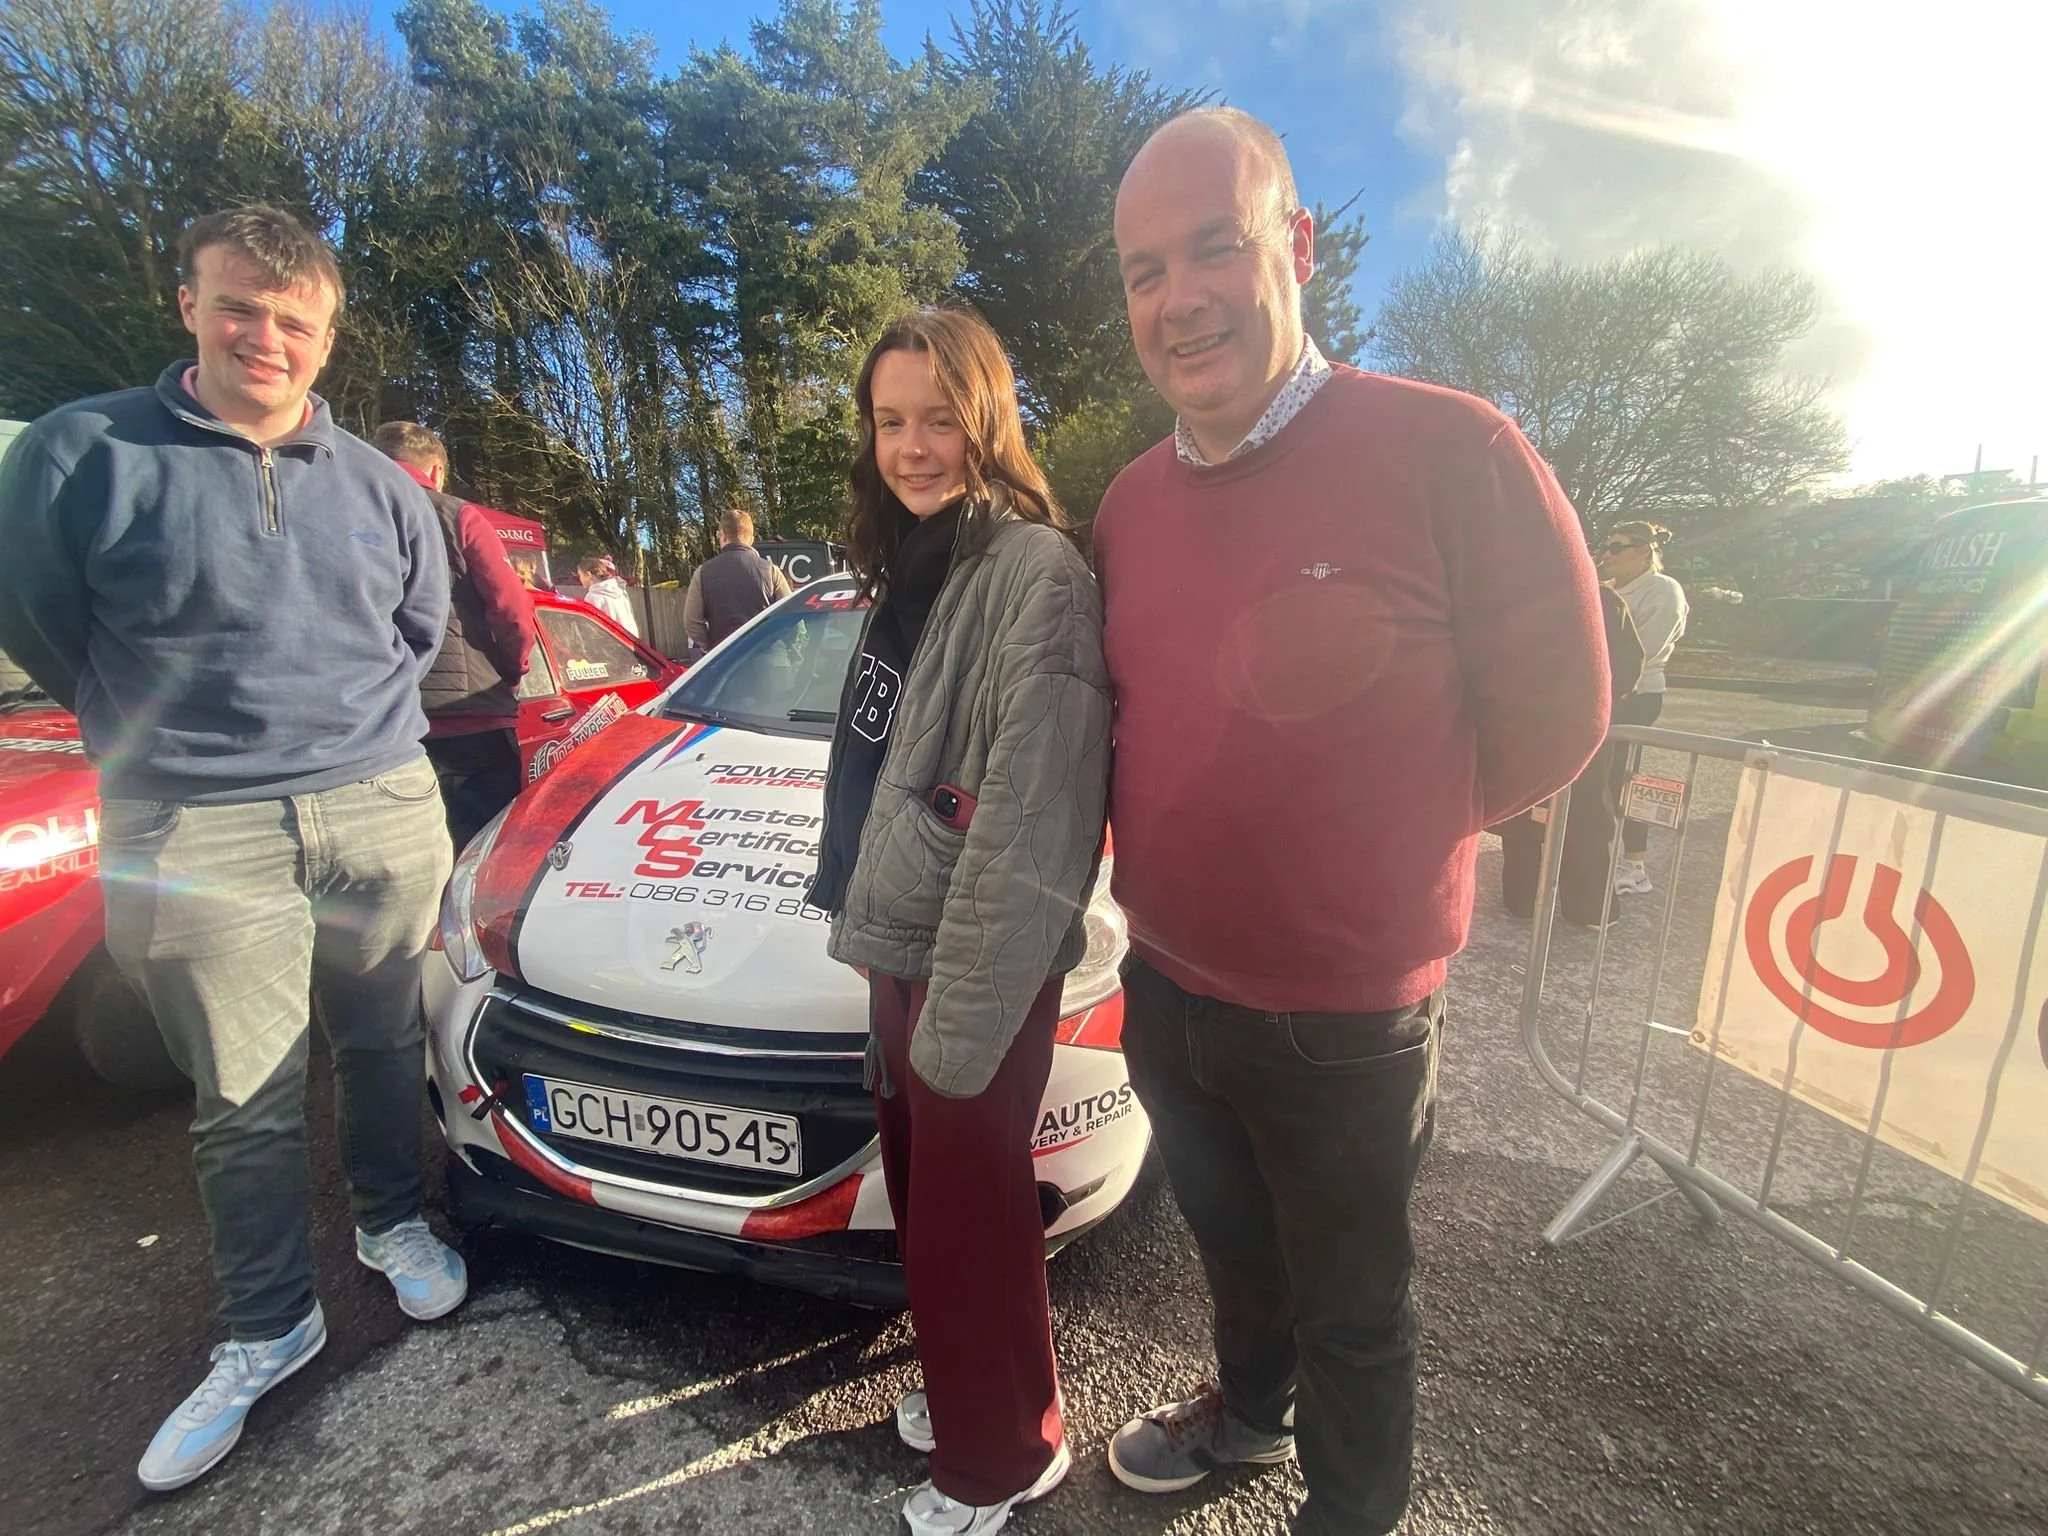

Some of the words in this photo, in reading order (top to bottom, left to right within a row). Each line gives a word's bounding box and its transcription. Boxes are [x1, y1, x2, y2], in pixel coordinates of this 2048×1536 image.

[567, 666, 607, 680] FULLER
[704, 764, 827, 782] POWER
[710, 776, 825, 790] MOTORS
[1634, 786, 1678, 804] HAYES
[614, 800, 824, 830] Munster
[564, 882, 625, 899] TEL:
[629, 882, 699, 903] 086
[702, 889, 770, 912] 316
[533, 1107, 549, 1123] PL
[1037, 1081, 1132, 1137] AUTOS
[1072, 1125, 1082, 1136] &
[1086, 1103, 1132, 1132] REPAIR
[551, 1087, 633, 1142] GCH
[646, 1104, 792, 1166] 90545
